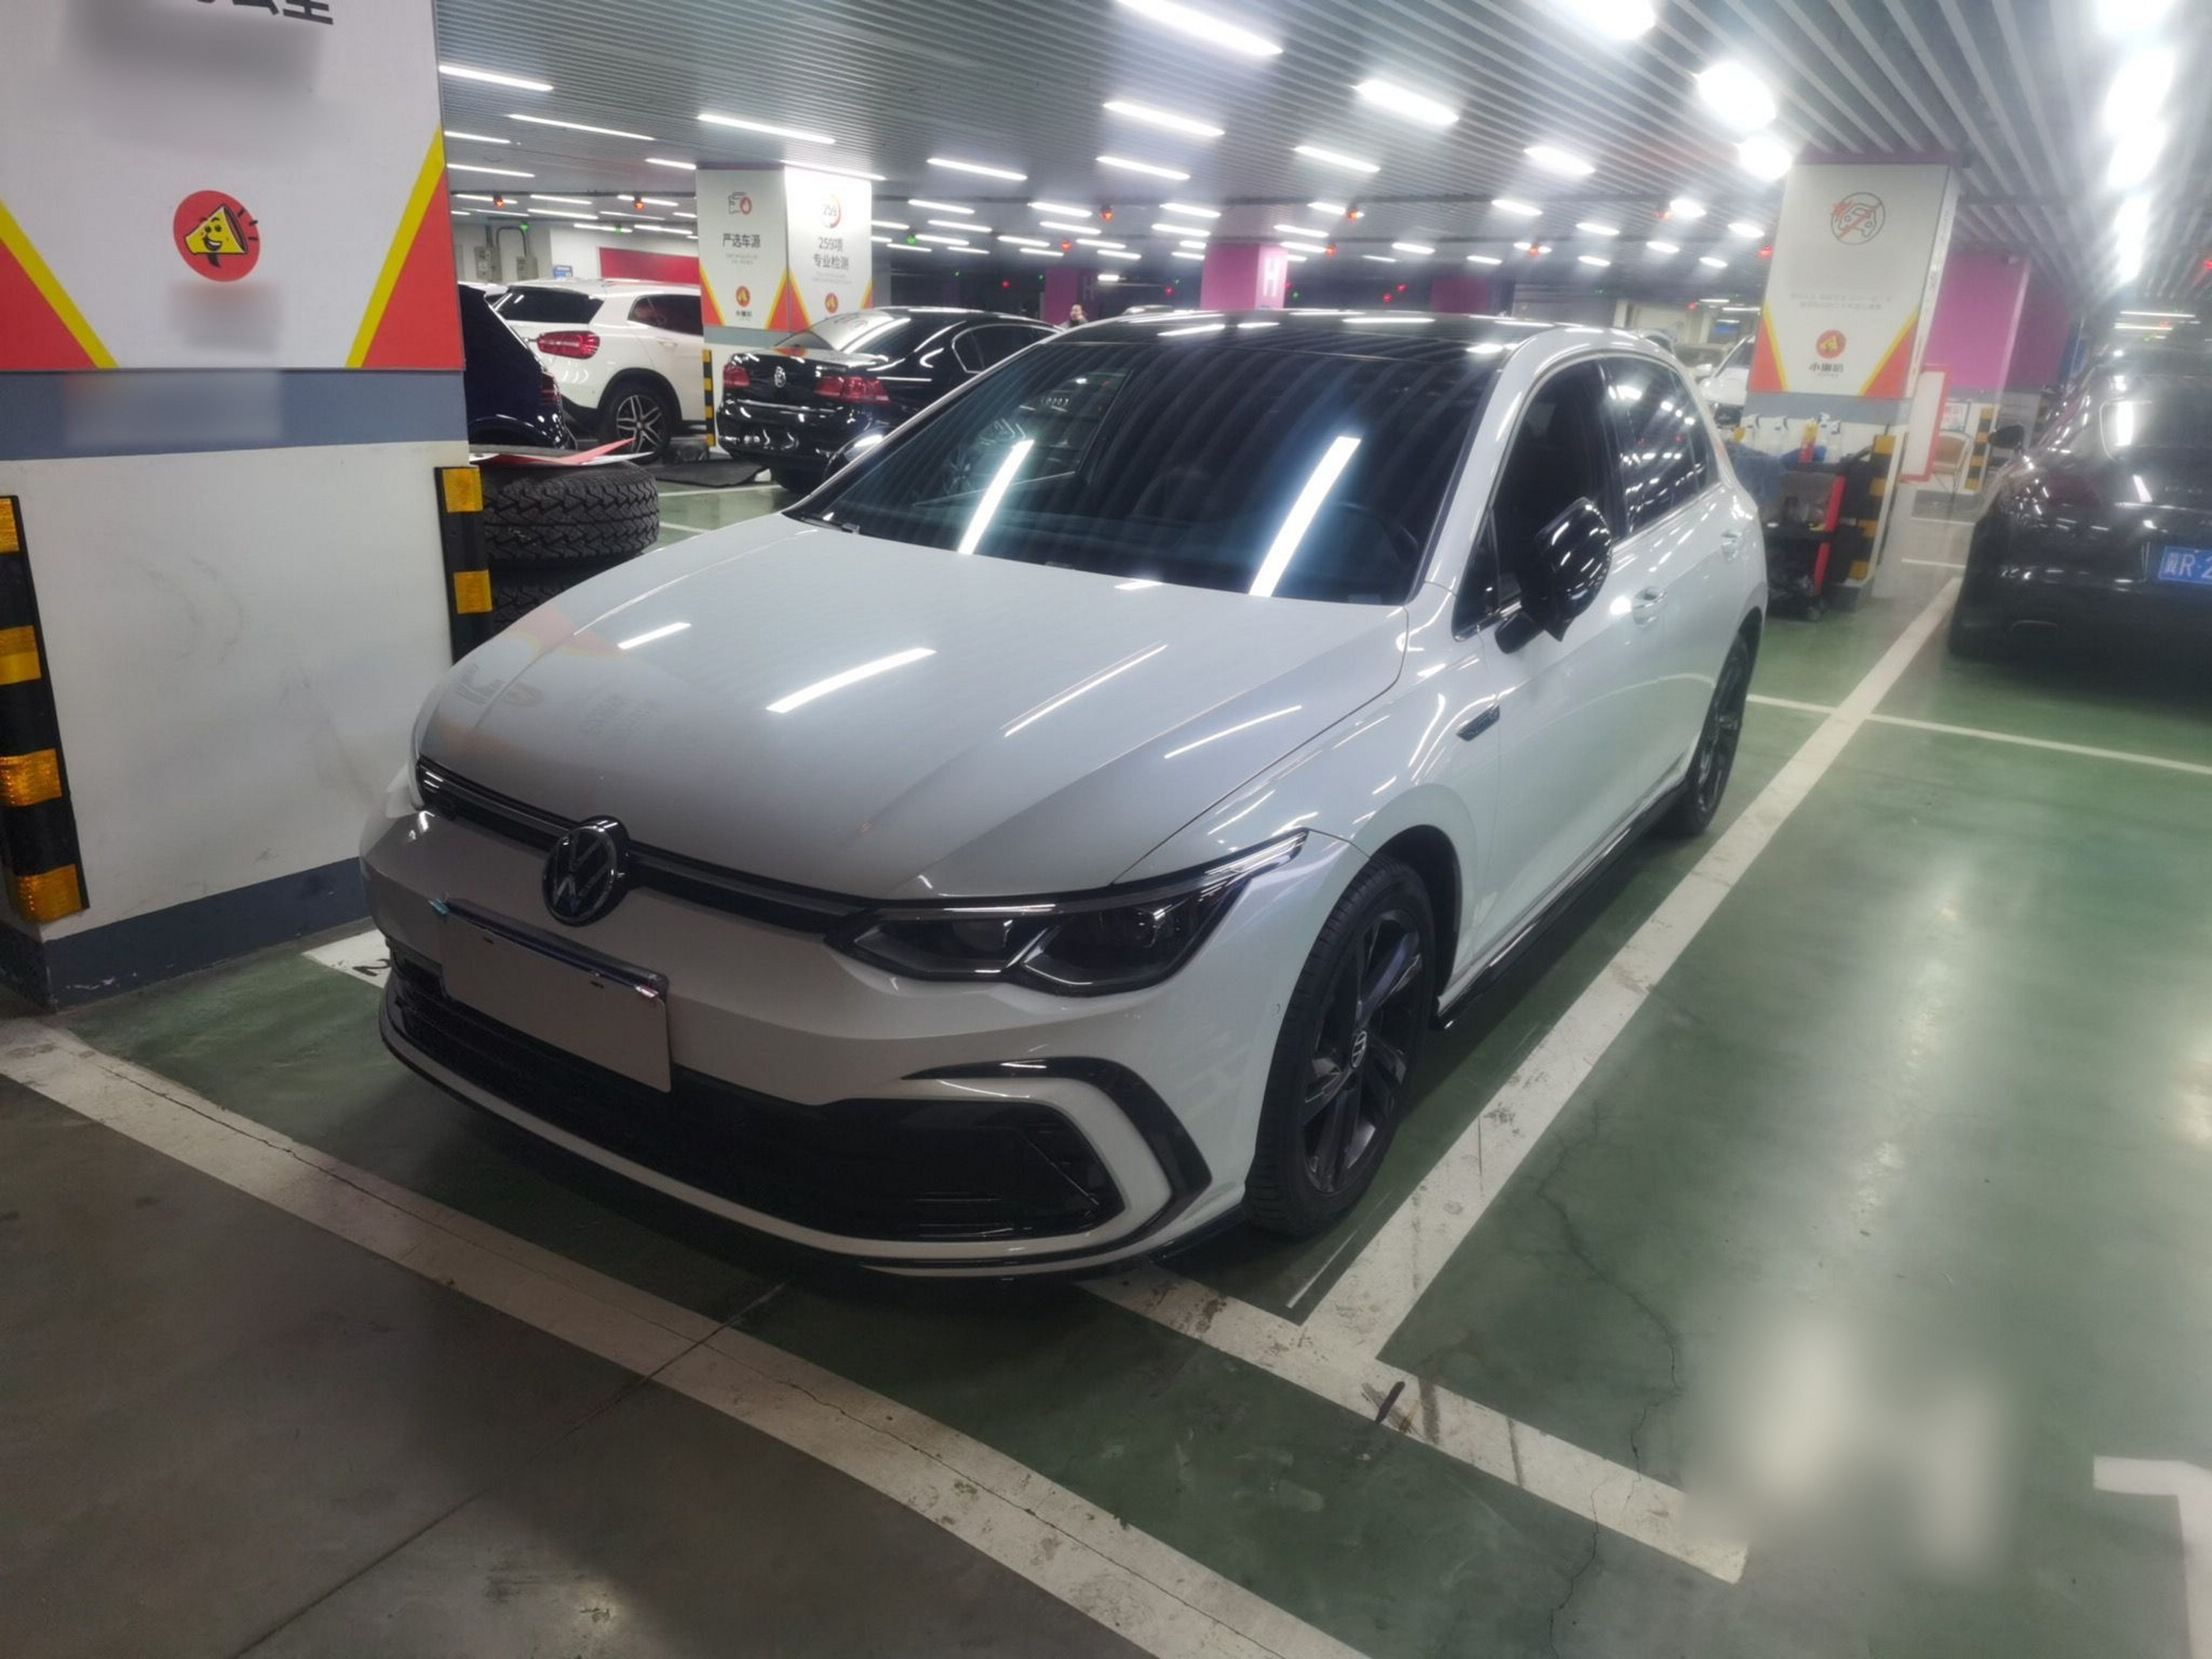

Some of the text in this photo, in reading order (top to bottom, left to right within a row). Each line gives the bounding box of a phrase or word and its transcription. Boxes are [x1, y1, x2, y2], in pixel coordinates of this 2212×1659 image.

[722, 233, 761, 248] 严选车源
[819, 237, 843, 252] 259项
[813, 253, 849, 271] 专业检测
